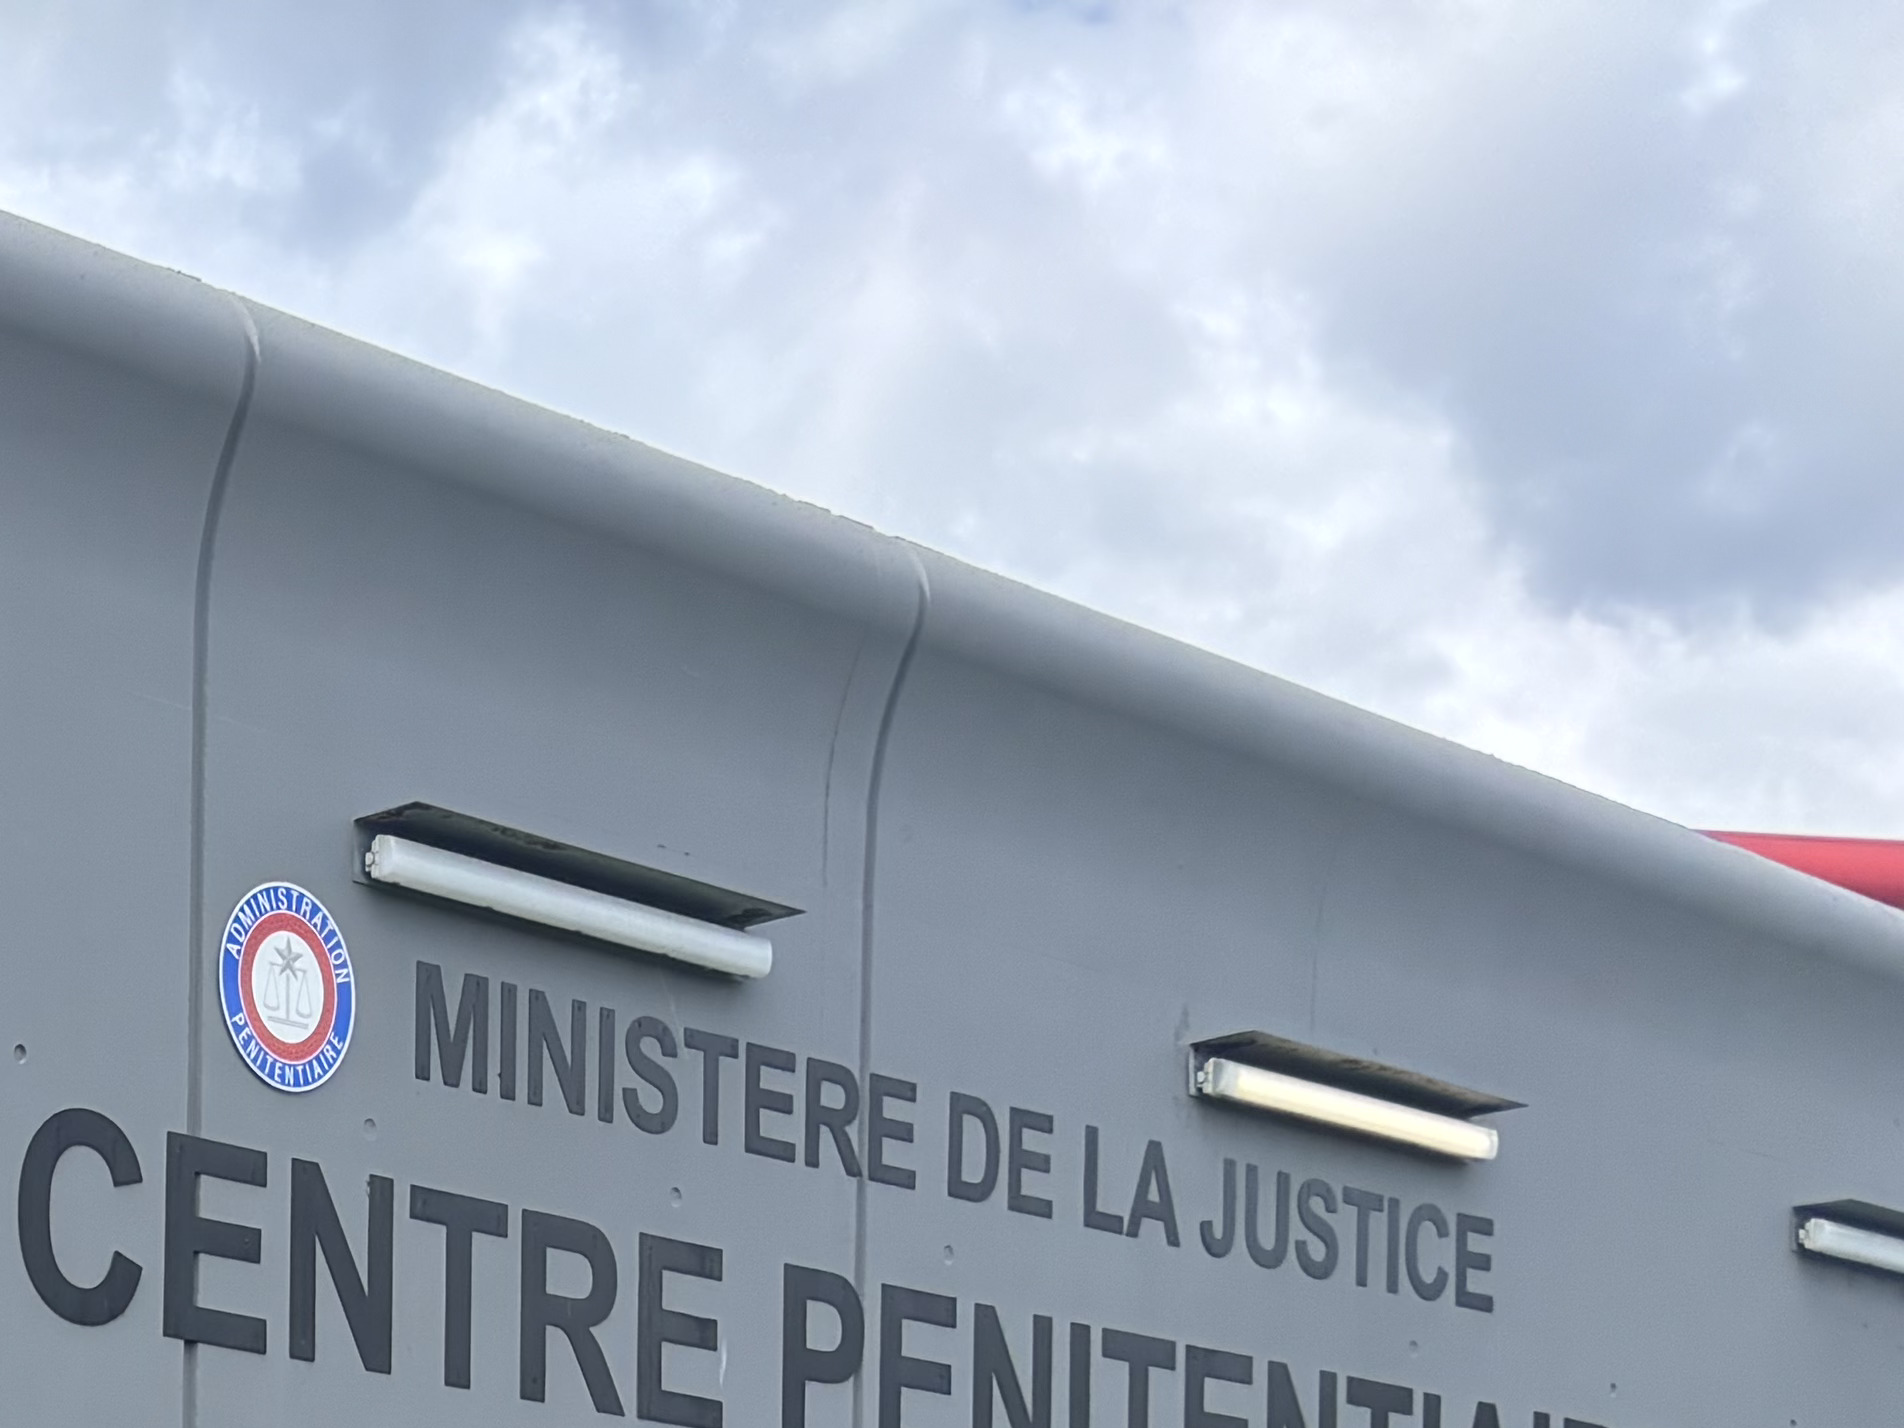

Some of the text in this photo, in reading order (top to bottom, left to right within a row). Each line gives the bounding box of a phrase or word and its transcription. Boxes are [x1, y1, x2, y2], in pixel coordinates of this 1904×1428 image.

[226, 887, 350, 984] ADMINISTRATION
[231, 1012, 344, 1088] PENITENTIAIRE
[414, 960, 1495, 1315] MINISTERE DE LA JUSTICE
